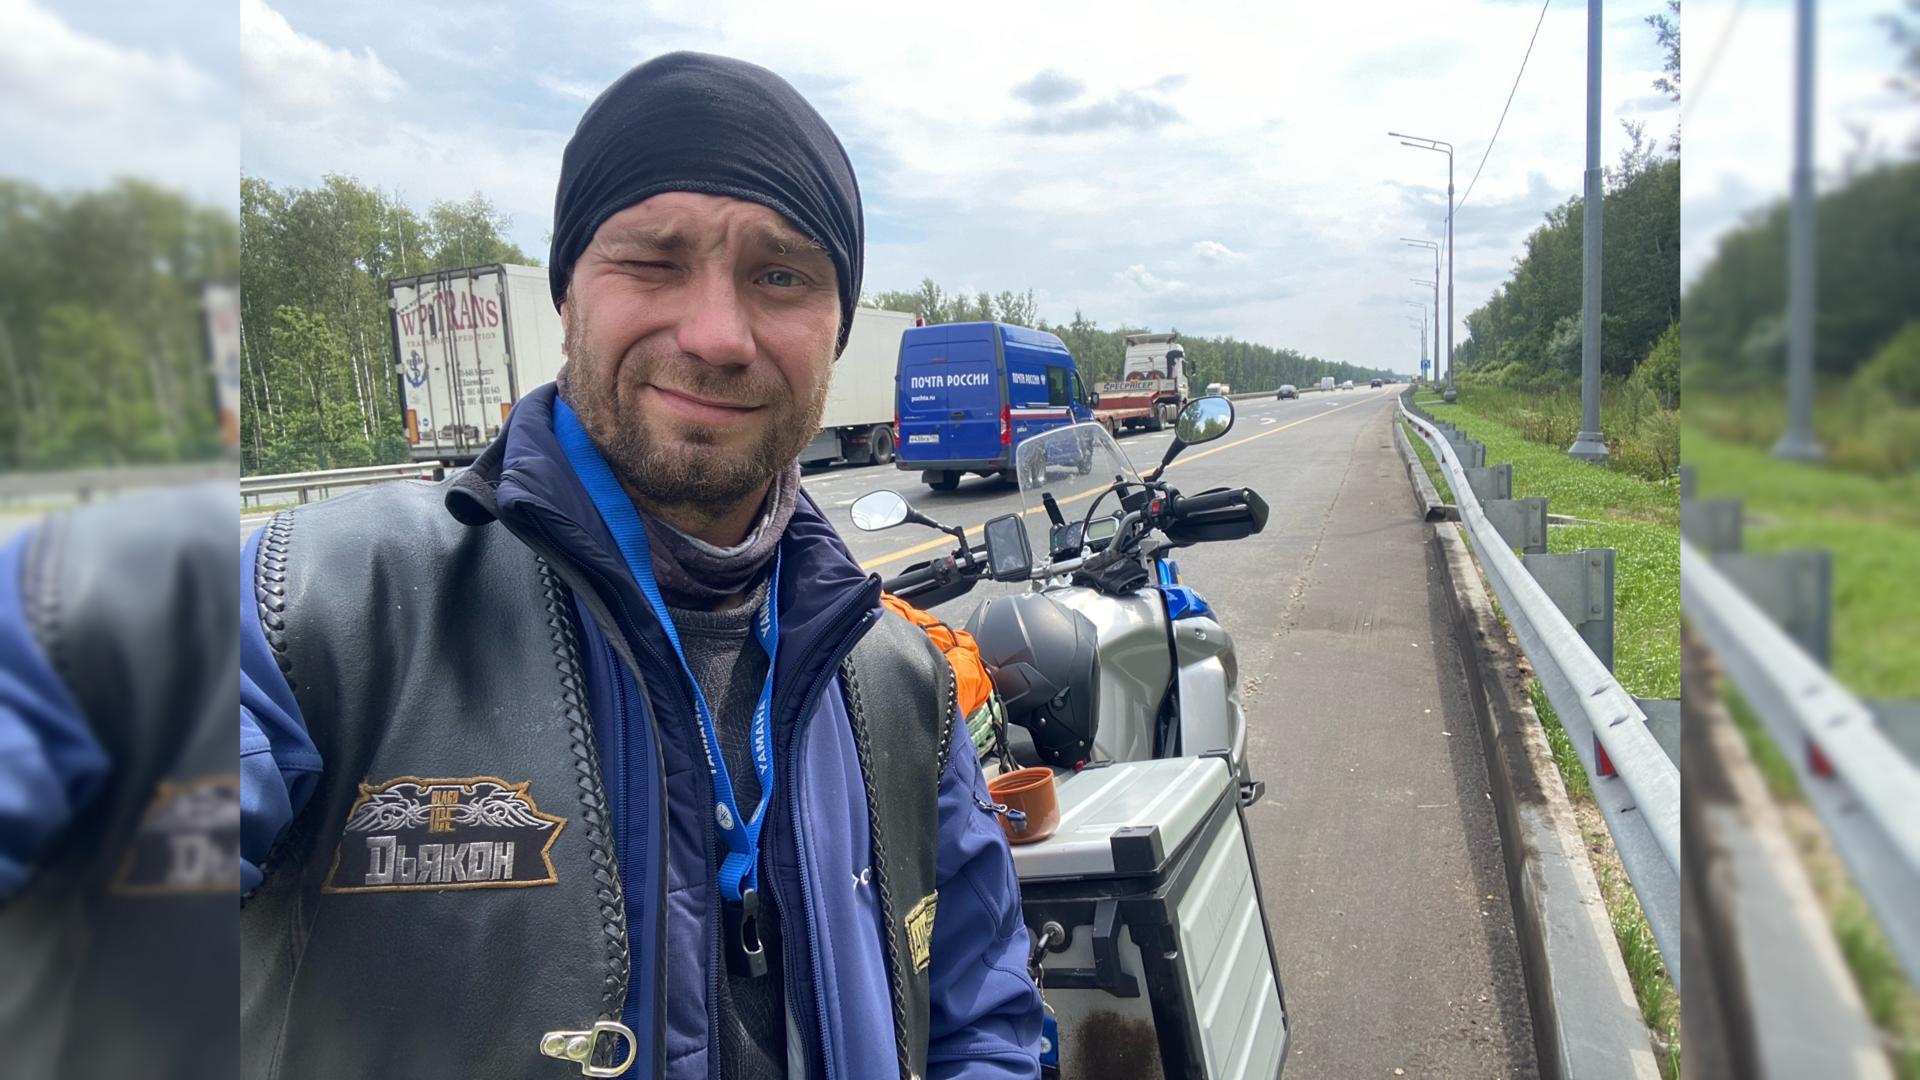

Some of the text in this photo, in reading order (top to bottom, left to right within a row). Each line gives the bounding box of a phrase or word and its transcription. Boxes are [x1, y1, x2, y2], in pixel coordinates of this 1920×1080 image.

[911, 373, 989, 389] ПОЧТА РОССИИ
[756, 698, 768, 776] YAMAHA
